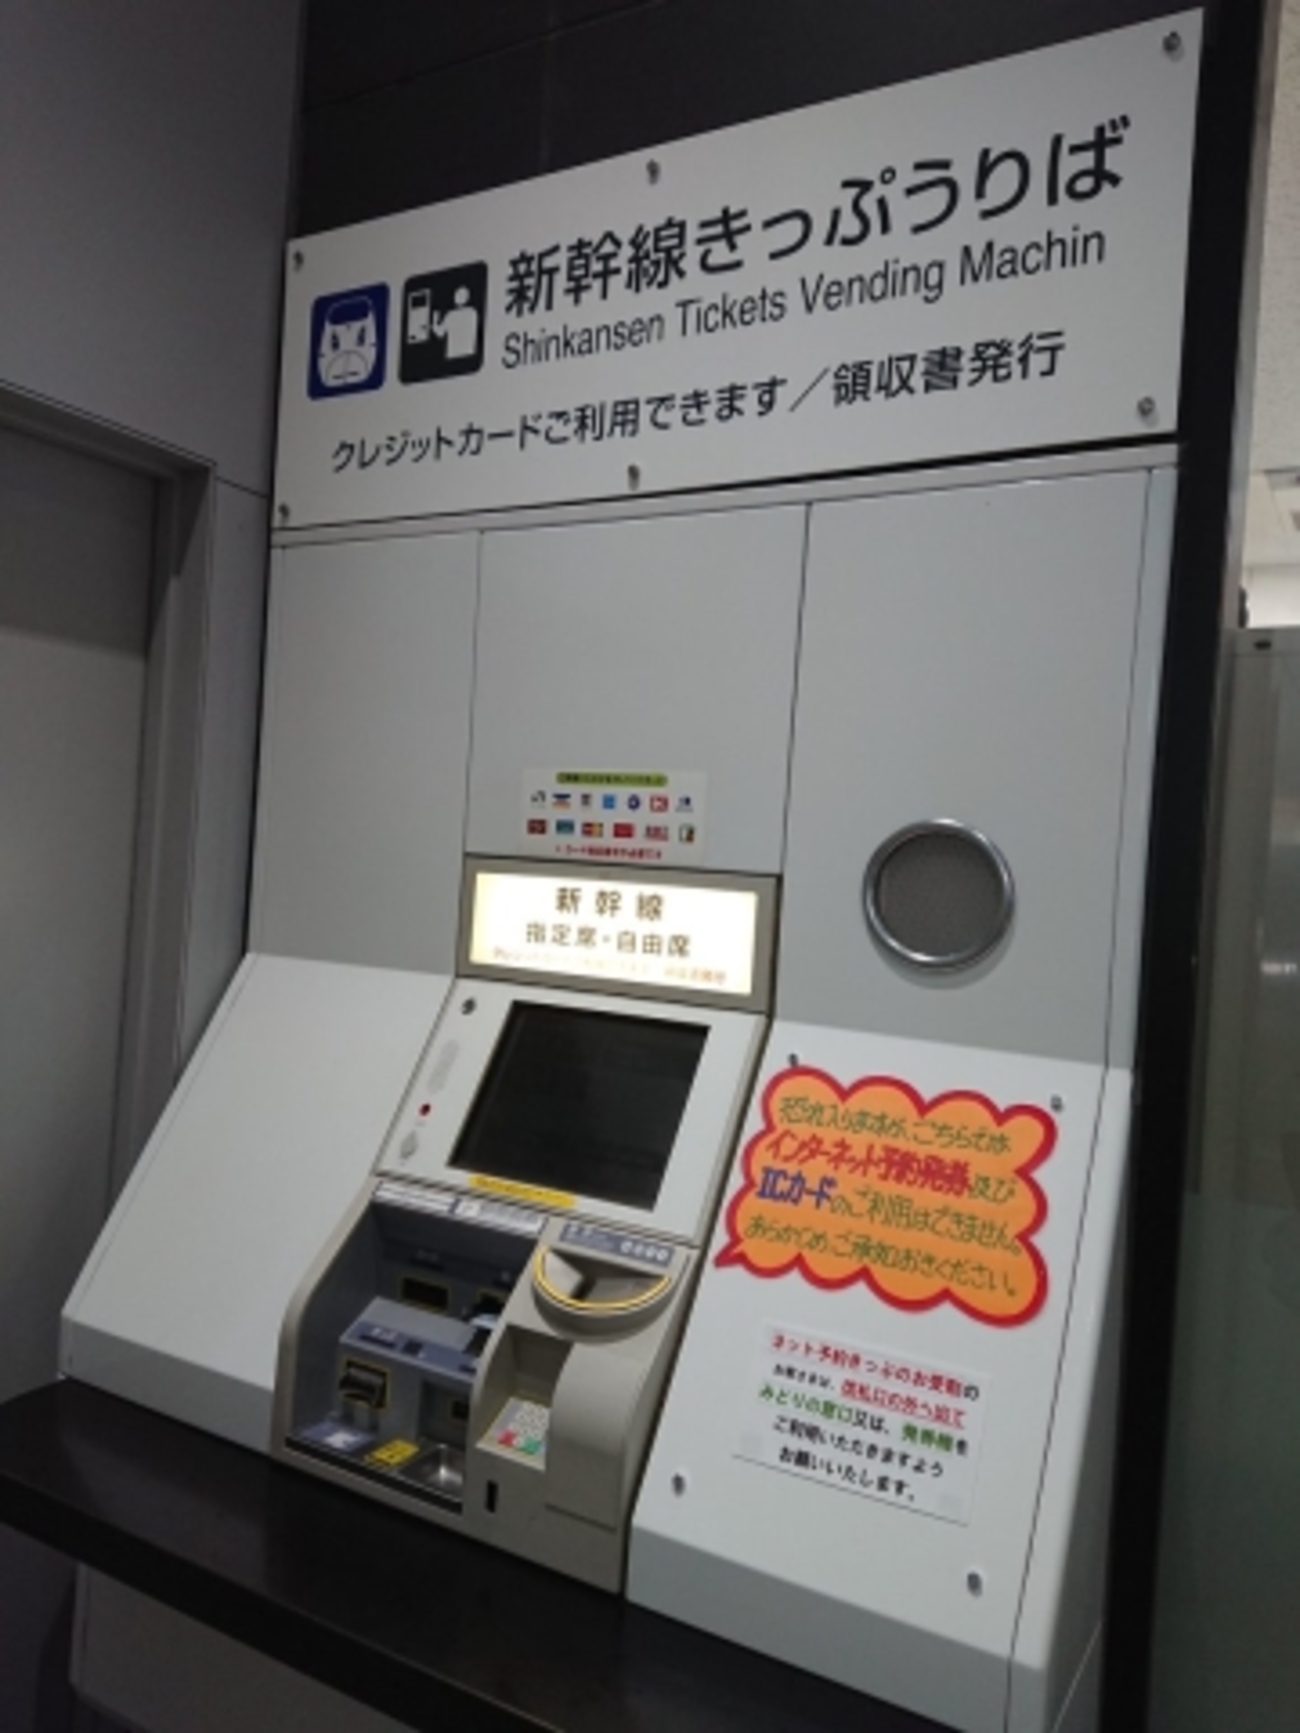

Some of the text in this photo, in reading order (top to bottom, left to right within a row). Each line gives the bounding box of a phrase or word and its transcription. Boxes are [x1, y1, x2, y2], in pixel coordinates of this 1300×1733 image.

[502, 113, 1133, 319] 新幹線きっぷうりば
[501, 226, 1107, 370] Shinkansen Tickets Vending Machin
[331, 330, 1067, 475] クレジットカードご利用できます／領収書発行
[555, 886, 664, 922] 新幹線
